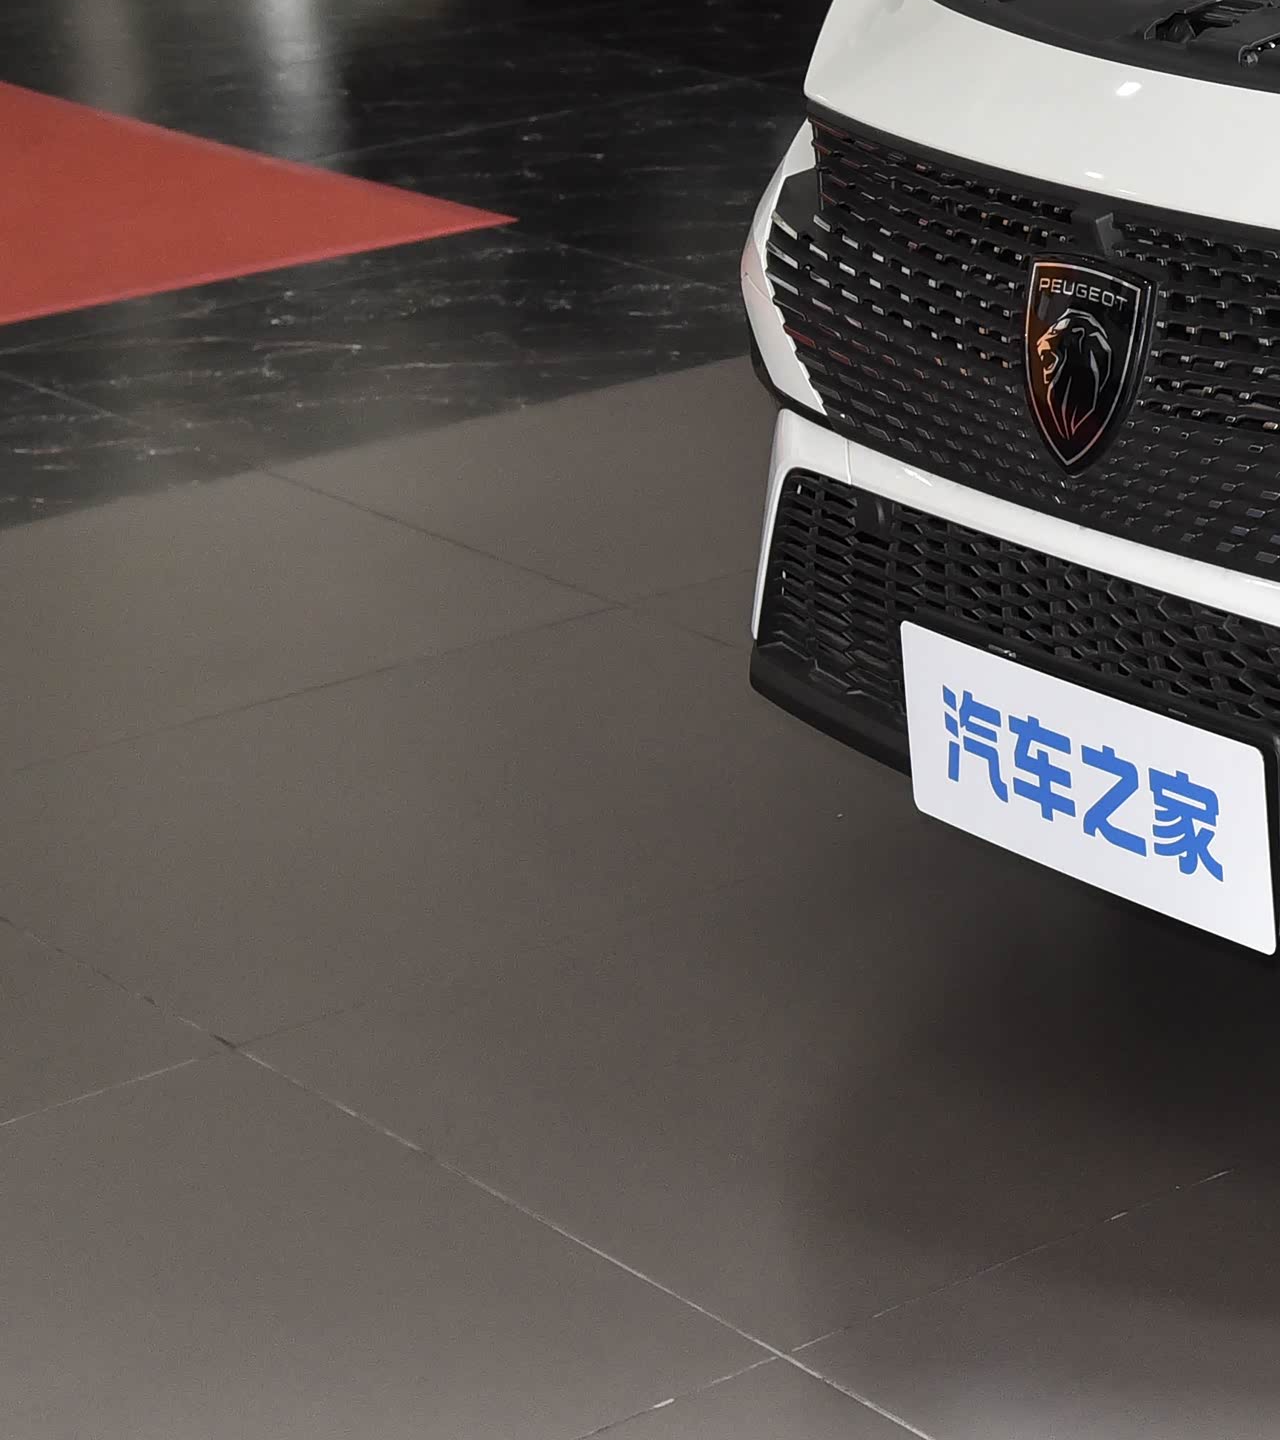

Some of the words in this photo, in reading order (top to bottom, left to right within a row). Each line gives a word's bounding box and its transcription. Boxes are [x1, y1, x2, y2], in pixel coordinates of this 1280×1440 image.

[1038, 278, 1128, 312] PEUGEOT
[942, 684, 1224, 881] 汽车之家
